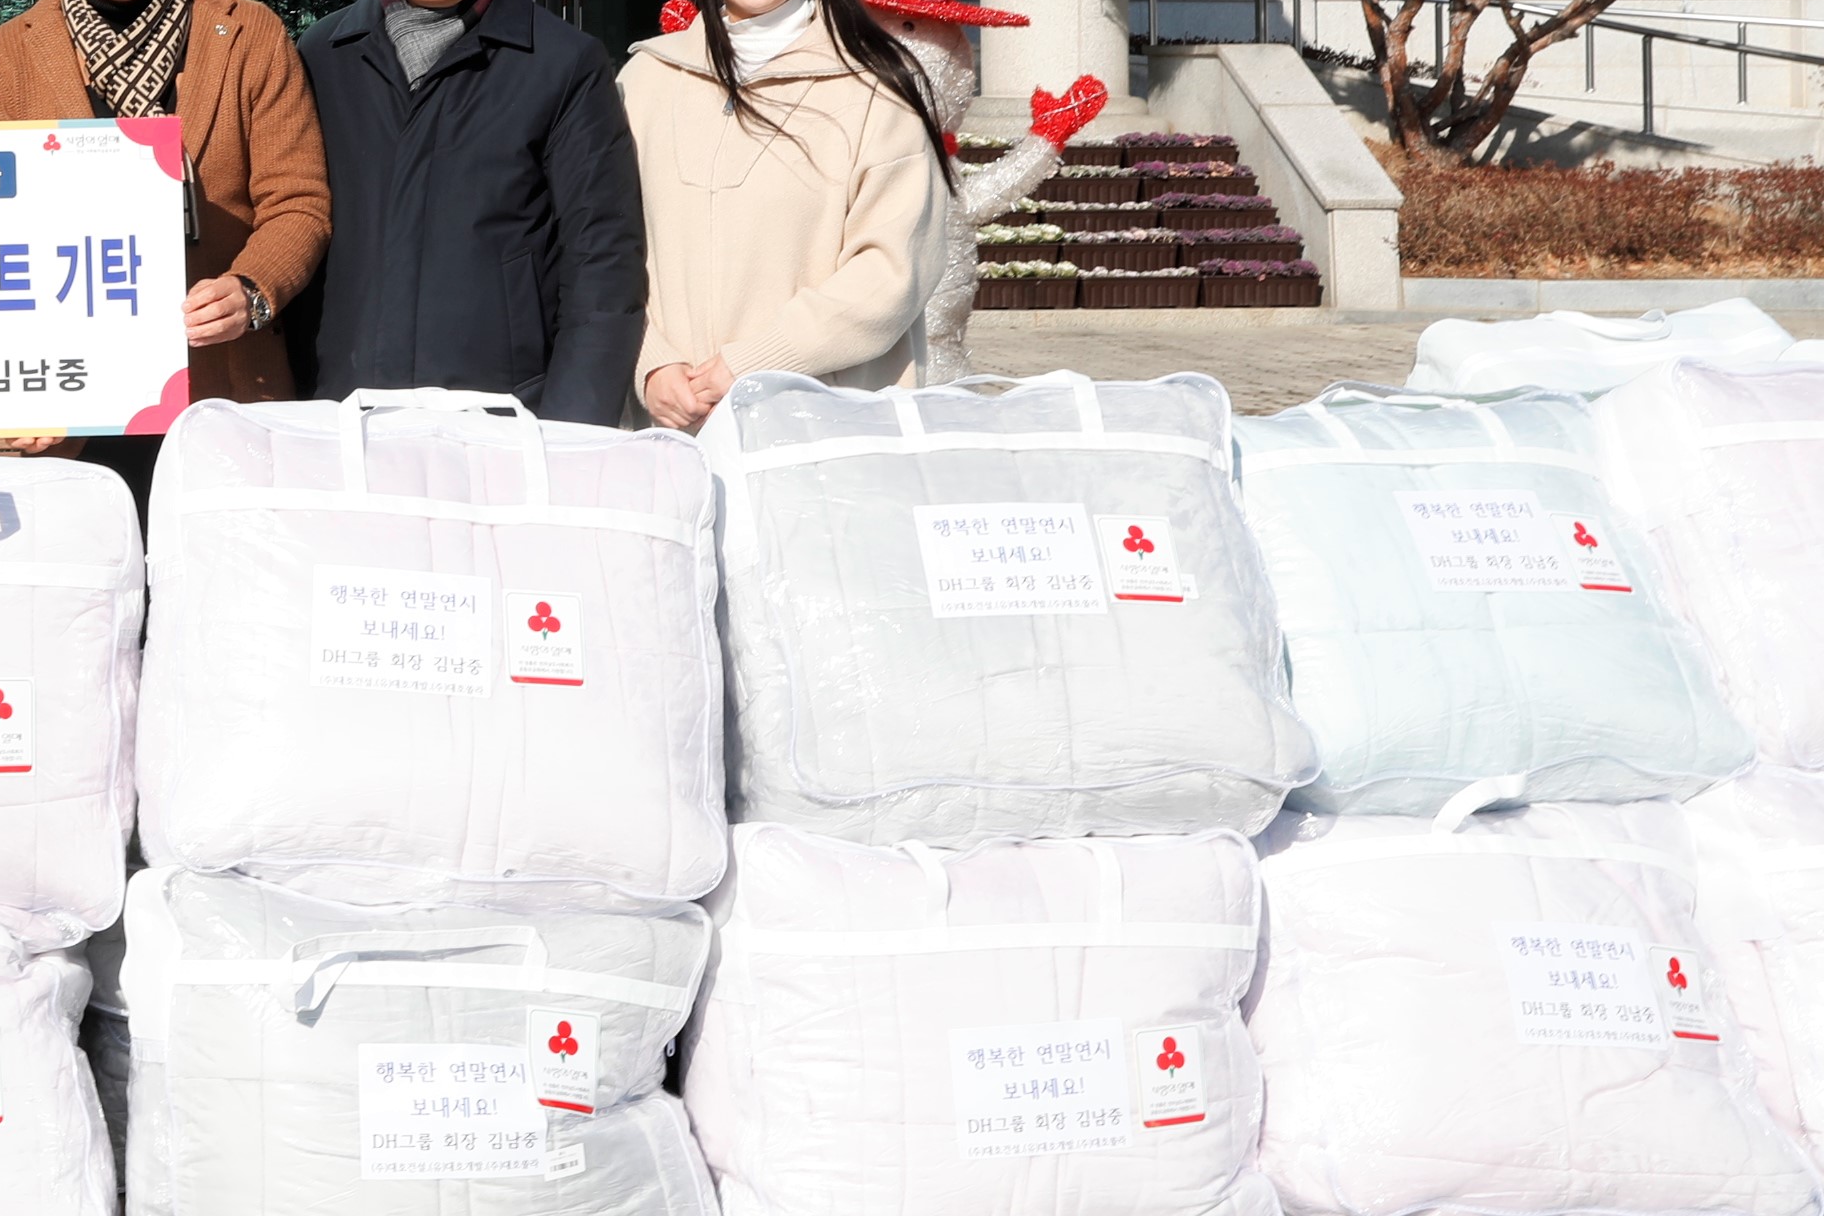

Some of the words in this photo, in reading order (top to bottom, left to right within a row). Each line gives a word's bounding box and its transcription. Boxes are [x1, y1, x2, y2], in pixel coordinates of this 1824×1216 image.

[56, 234, 143, 319] 기탁
[329, 584, 389, 607] 행복한
[400, 590, 476, 613] 연말연시
[360, 620, 446, 641] 보내세요!
[322, 649, 381, 668] DH그룹
[391, 653, 423, 671] 회장
[433, 655, 484, 675] 김남중
[967, 1045, 1025, 1070] 행복한
[1037, 1038, 1111, 1065] 연말연시
[376, 1061, 436, 1083] 행복한
[449, 1061, 526, 1084] 연말연시
[1003, 1077, 1085, 1100] 보내세요!
[410, 1097, 498, 1117] 보내세요!
[967, 1116, 1025, 1134] DH그룹
[1035, 1111, 1066, 1131] 회장
[1076, 1107, 1123, 1127] 김남중
[372, 1134, 433, 1151] DH그룹
[443, 1132, 477, 1151] 회장
[488, 1131, 539, 1149] 김남중
